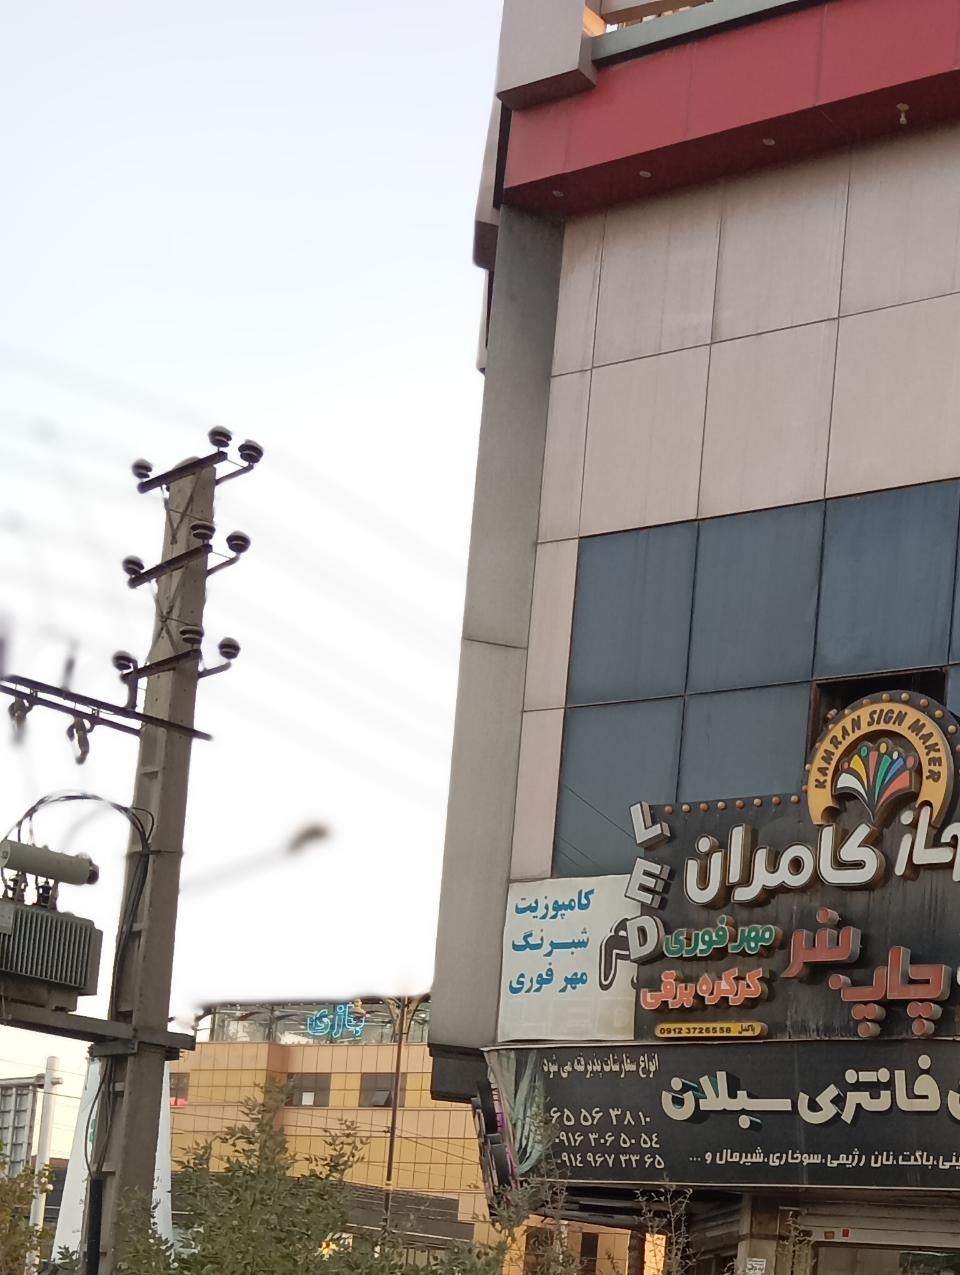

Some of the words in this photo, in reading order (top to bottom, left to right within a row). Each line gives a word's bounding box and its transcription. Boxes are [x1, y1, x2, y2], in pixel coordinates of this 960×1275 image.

[814, 714, 863, 790] KAMRAN
[867, 708, 908, 727] SIGN
[906, 718, 943, 784] MAKER
[684, 822, 885, 905] کامران
[513, 889, 595, 920] کامپوزیت
[511, 927, 590, 958] شبرنگ
[663, 915, 730, 958] فوری
[730, 924, 776, 955] مهر
[508, 962, 554, 995] فوری
[558, 969, 588, 993] مهر
[640, 970, 697, 1010] برقی
[697, 967, 763, 1006] کرکره
[840, 946, 952, 1037] چاپ
[659, 1026, 683, 1035] 0912
[602, 1053, 638, 1079] سفارشات
[640, 1053, 660, 1079] انواع
[661, 1070, 793, 1129] سبلان
[797, 1054, 942, 1125] فانتزی
[579, 1107, 604, 1126] ۵۶
